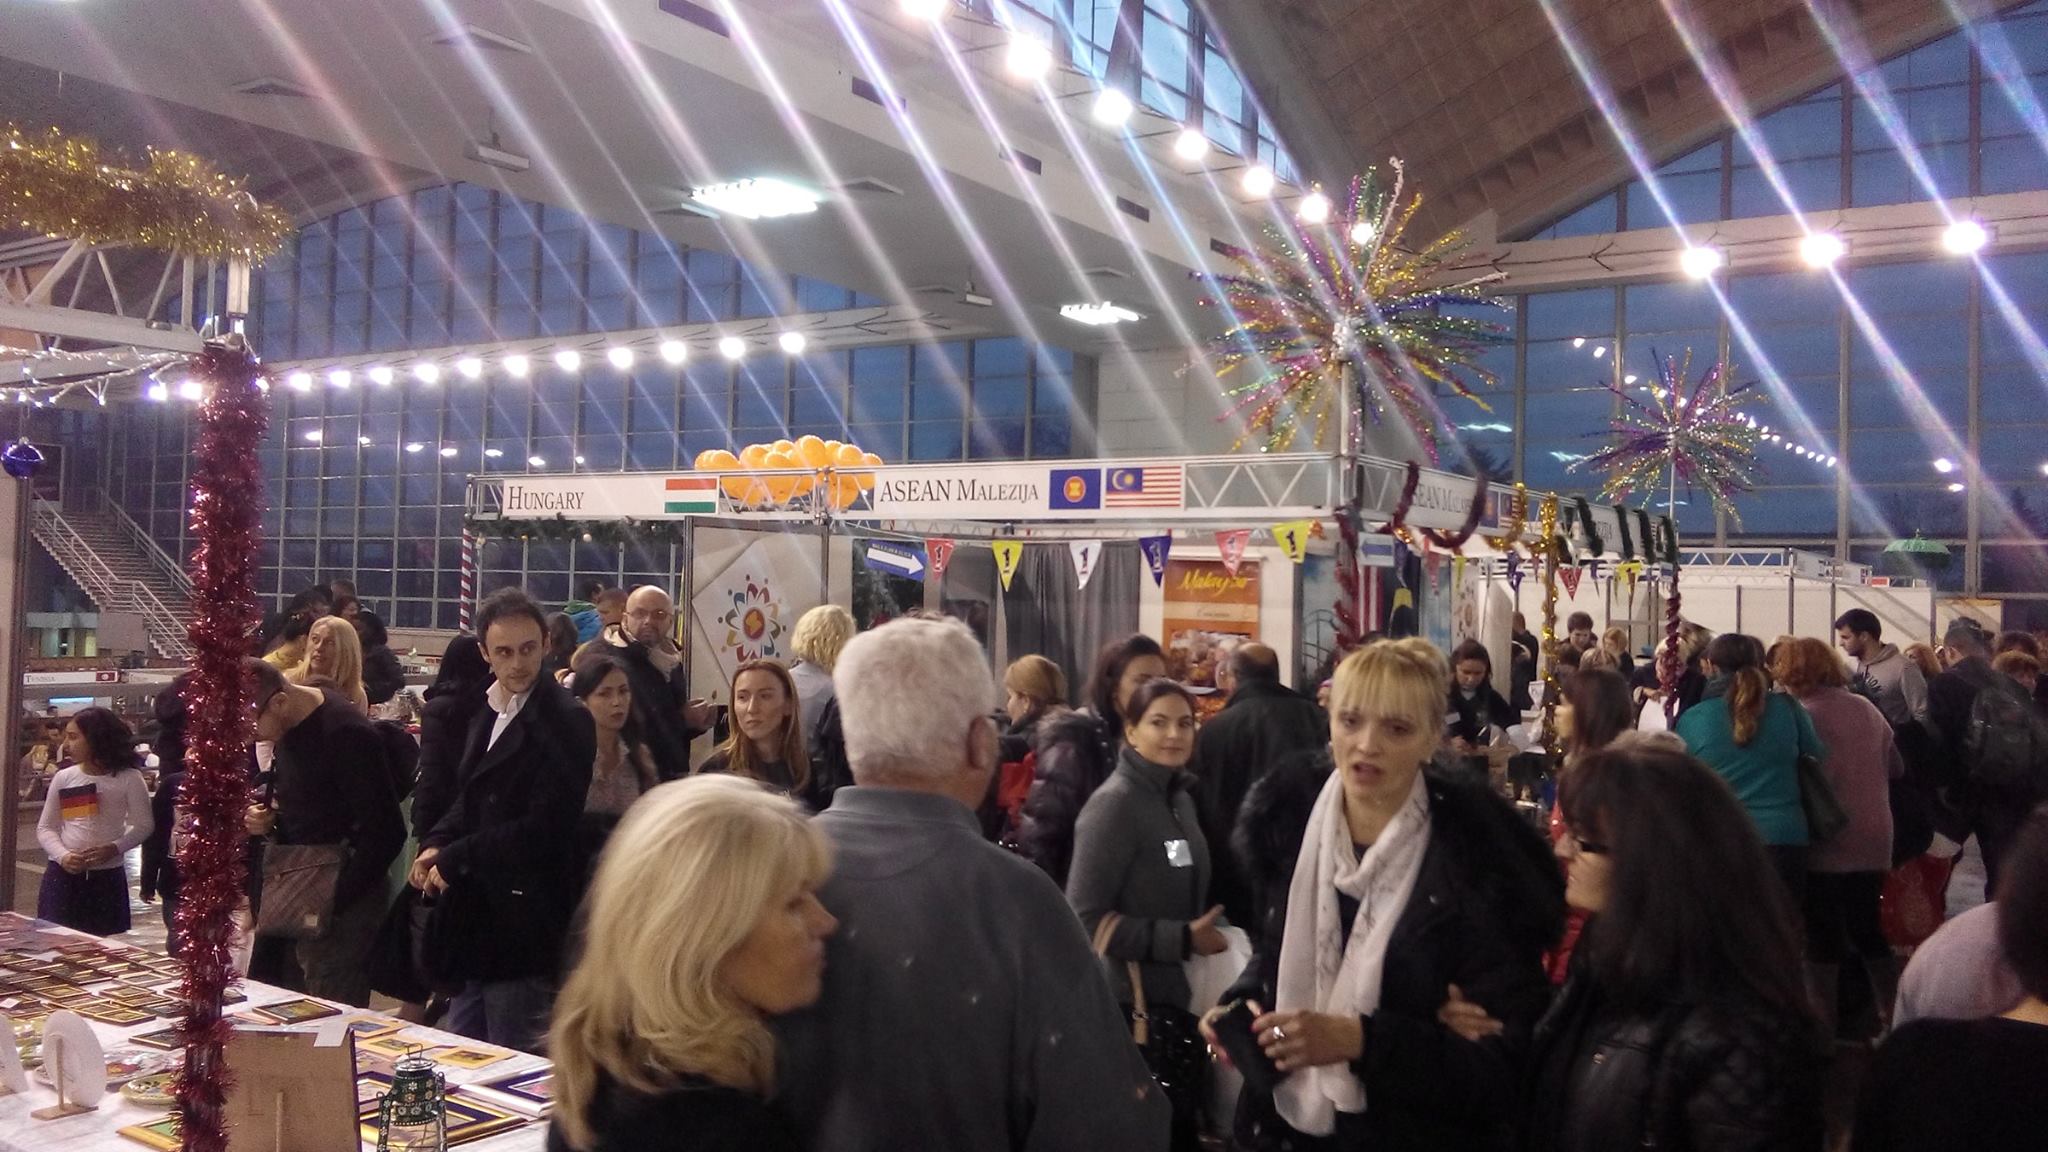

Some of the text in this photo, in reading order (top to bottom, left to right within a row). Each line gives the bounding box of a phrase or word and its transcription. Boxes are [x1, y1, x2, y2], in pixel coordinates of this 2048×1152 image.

[507, 486, 585, 511] HUNGARY
[879, 478, 1040, 504] ASEAN MALEZIJA
